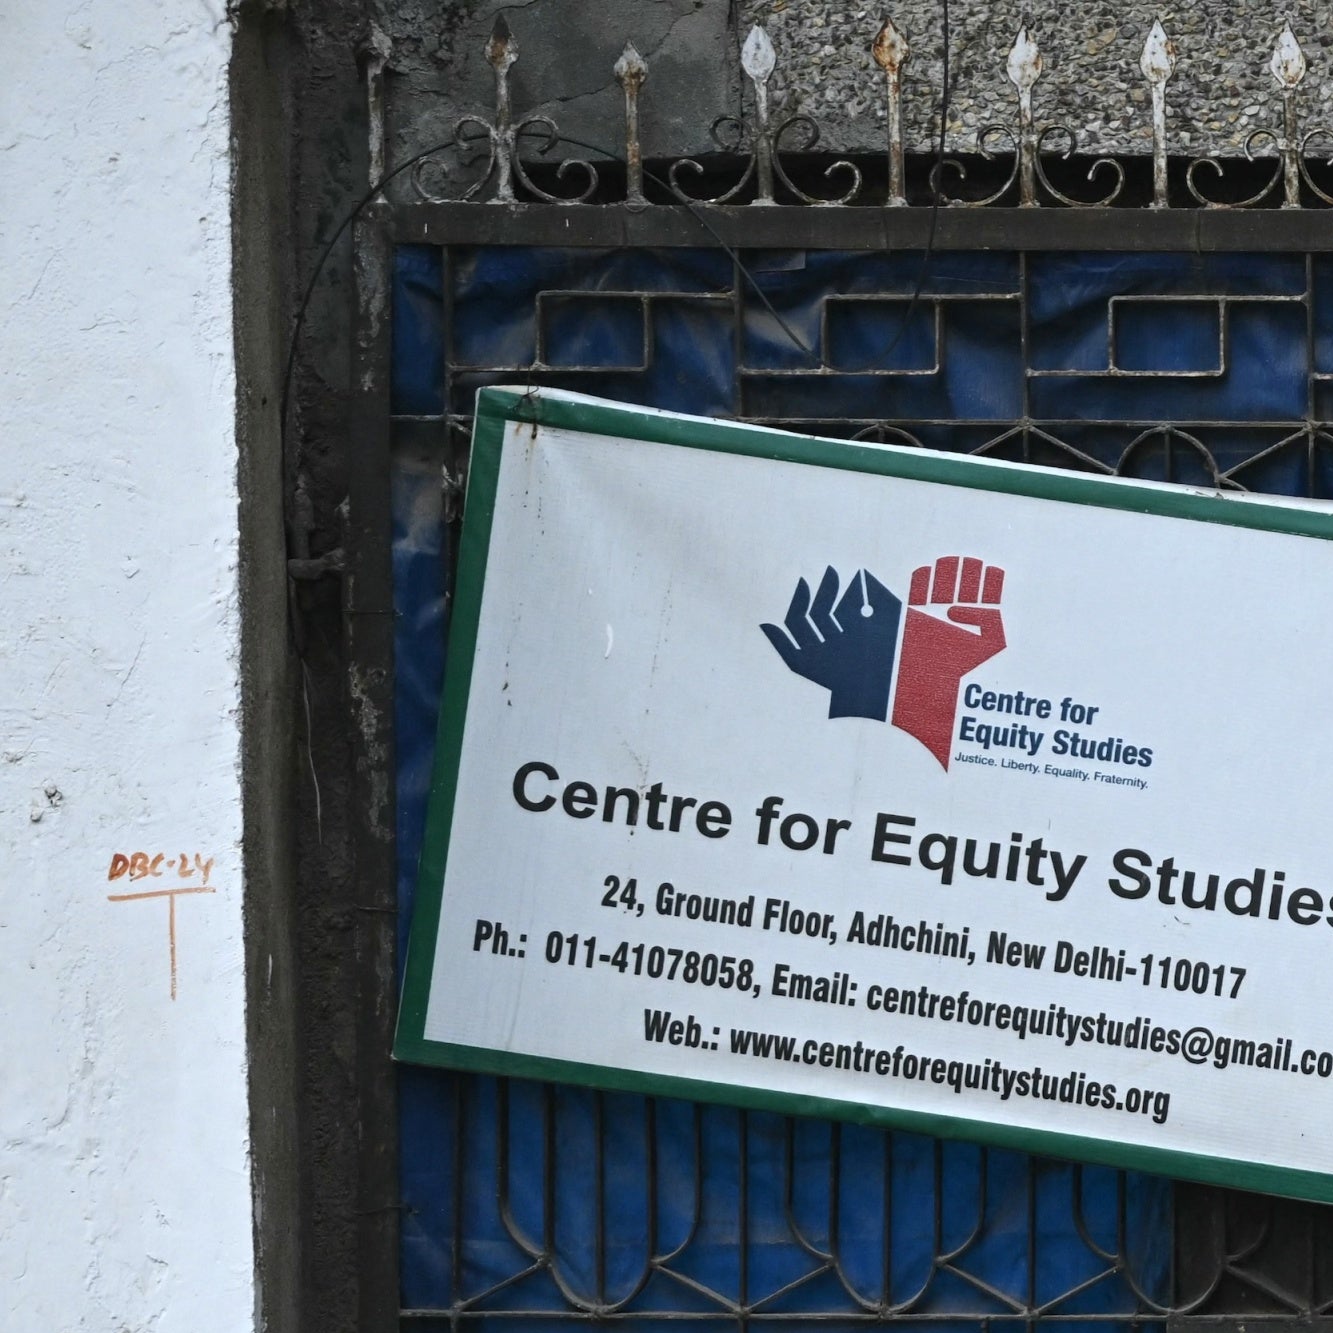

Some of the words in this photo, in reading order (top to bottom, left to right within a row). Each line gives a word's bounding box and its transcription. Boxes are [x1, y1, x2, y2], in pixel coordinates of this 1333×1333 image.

[959, 716, 1045, 757] Equity
[1052, 730, 1153, 768] Studies
[964, 683, 1052, 719] Centre
[1060, 697, 1099, 726] for
[955, 752, 998, 767] Justice.
[1001, 759, 1041, 774] Liberty.
[1044, 764, 1091, 781] Equality.
[1093, 771, 1149, 790] Fraternity.
[512, 761, 732, 839] Centre
[755, 795, 853, 855] for
[870, 812, 1088, 902] Equity
[472, 918, 529, 960] Ph.:
[545, 930, 761, 999] 011-41078058,
[771, 963, 858, 1007] Email:
[601, 875, 645, 918] 24,
[655, 882, 756, 928] Ground
[762, 897, 838, 946] Floor,
[846, 910, 976, 966] Adhchini,
[986, 930, 1047, 970] New
[1053, 940, 1247, 1000] Delhi-110017
[644, 1008, 722, 1051] Web.:
[730, 1028, 1171, 1125] www.centreforequitystudies.org
